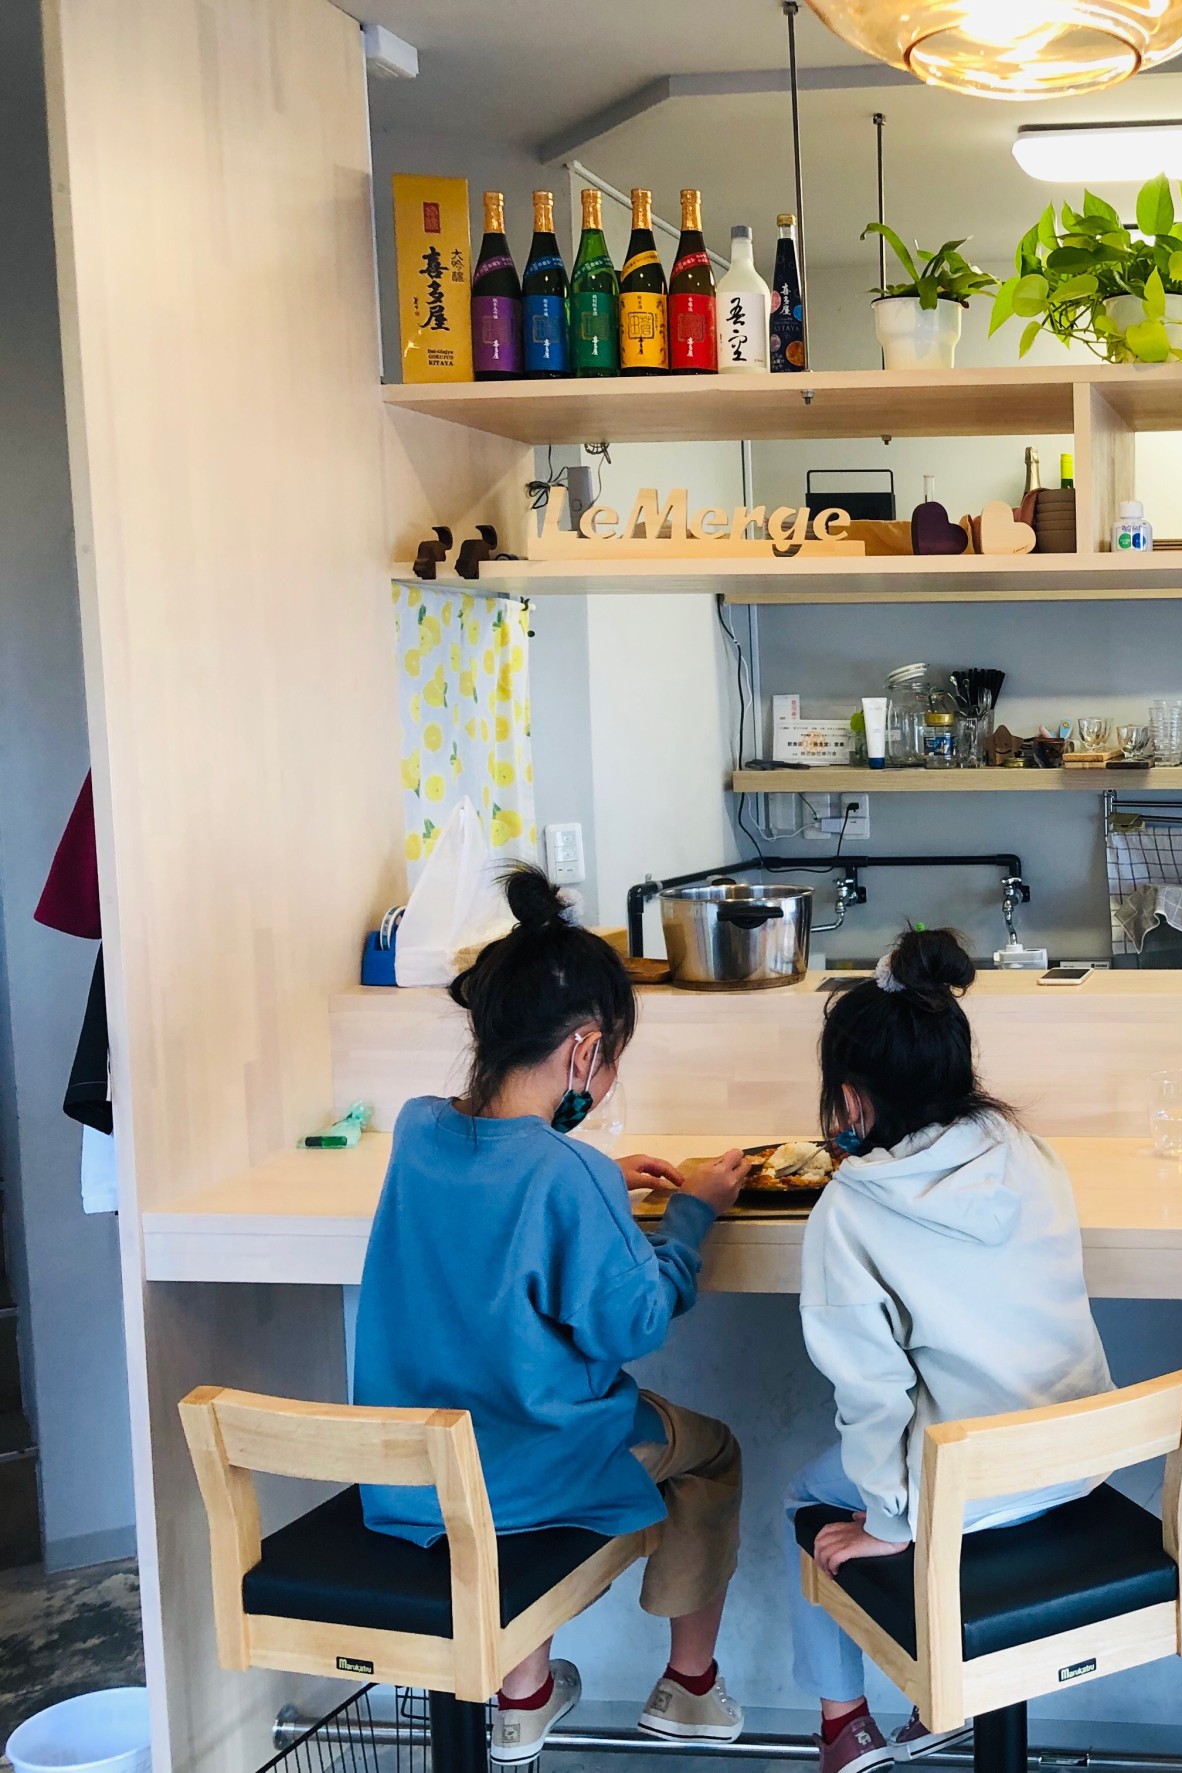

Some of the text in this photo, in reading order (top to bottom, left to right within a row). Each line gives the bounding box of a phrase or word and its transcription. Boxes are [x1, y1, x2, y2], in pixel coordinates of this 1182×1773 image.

[418, 246, 451, 331] 喜多屋
[451, 249, 465, 283] 大吟醸
[726, 297, 748, 361] 吾空
[780, 282, 792, 316] 喜多屋
[541, 486, 851, 557] LeMerge
